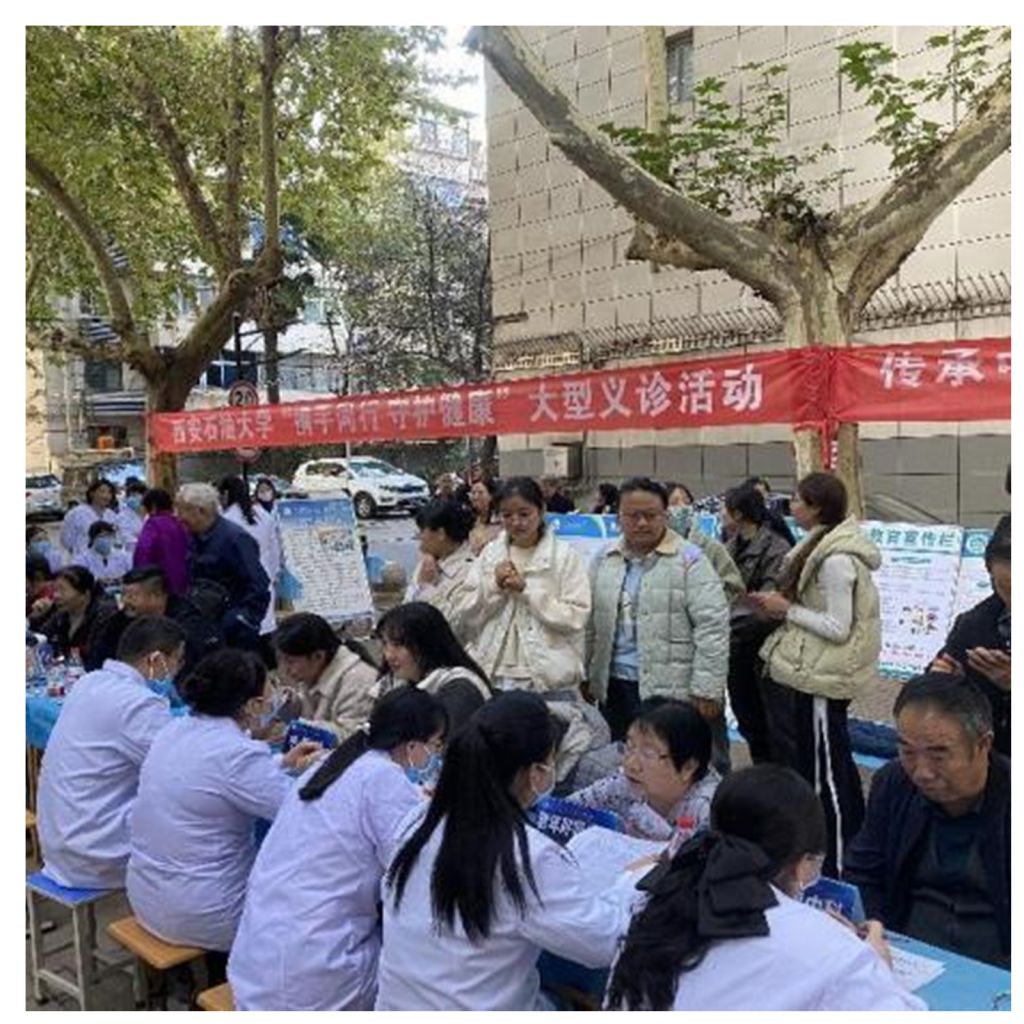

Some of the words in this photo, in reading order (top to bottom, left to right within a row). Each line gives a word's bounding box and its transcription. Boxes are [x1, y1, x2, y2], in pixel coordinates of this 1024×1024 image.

[528, 362, 764, 422] 大型义诊活动
